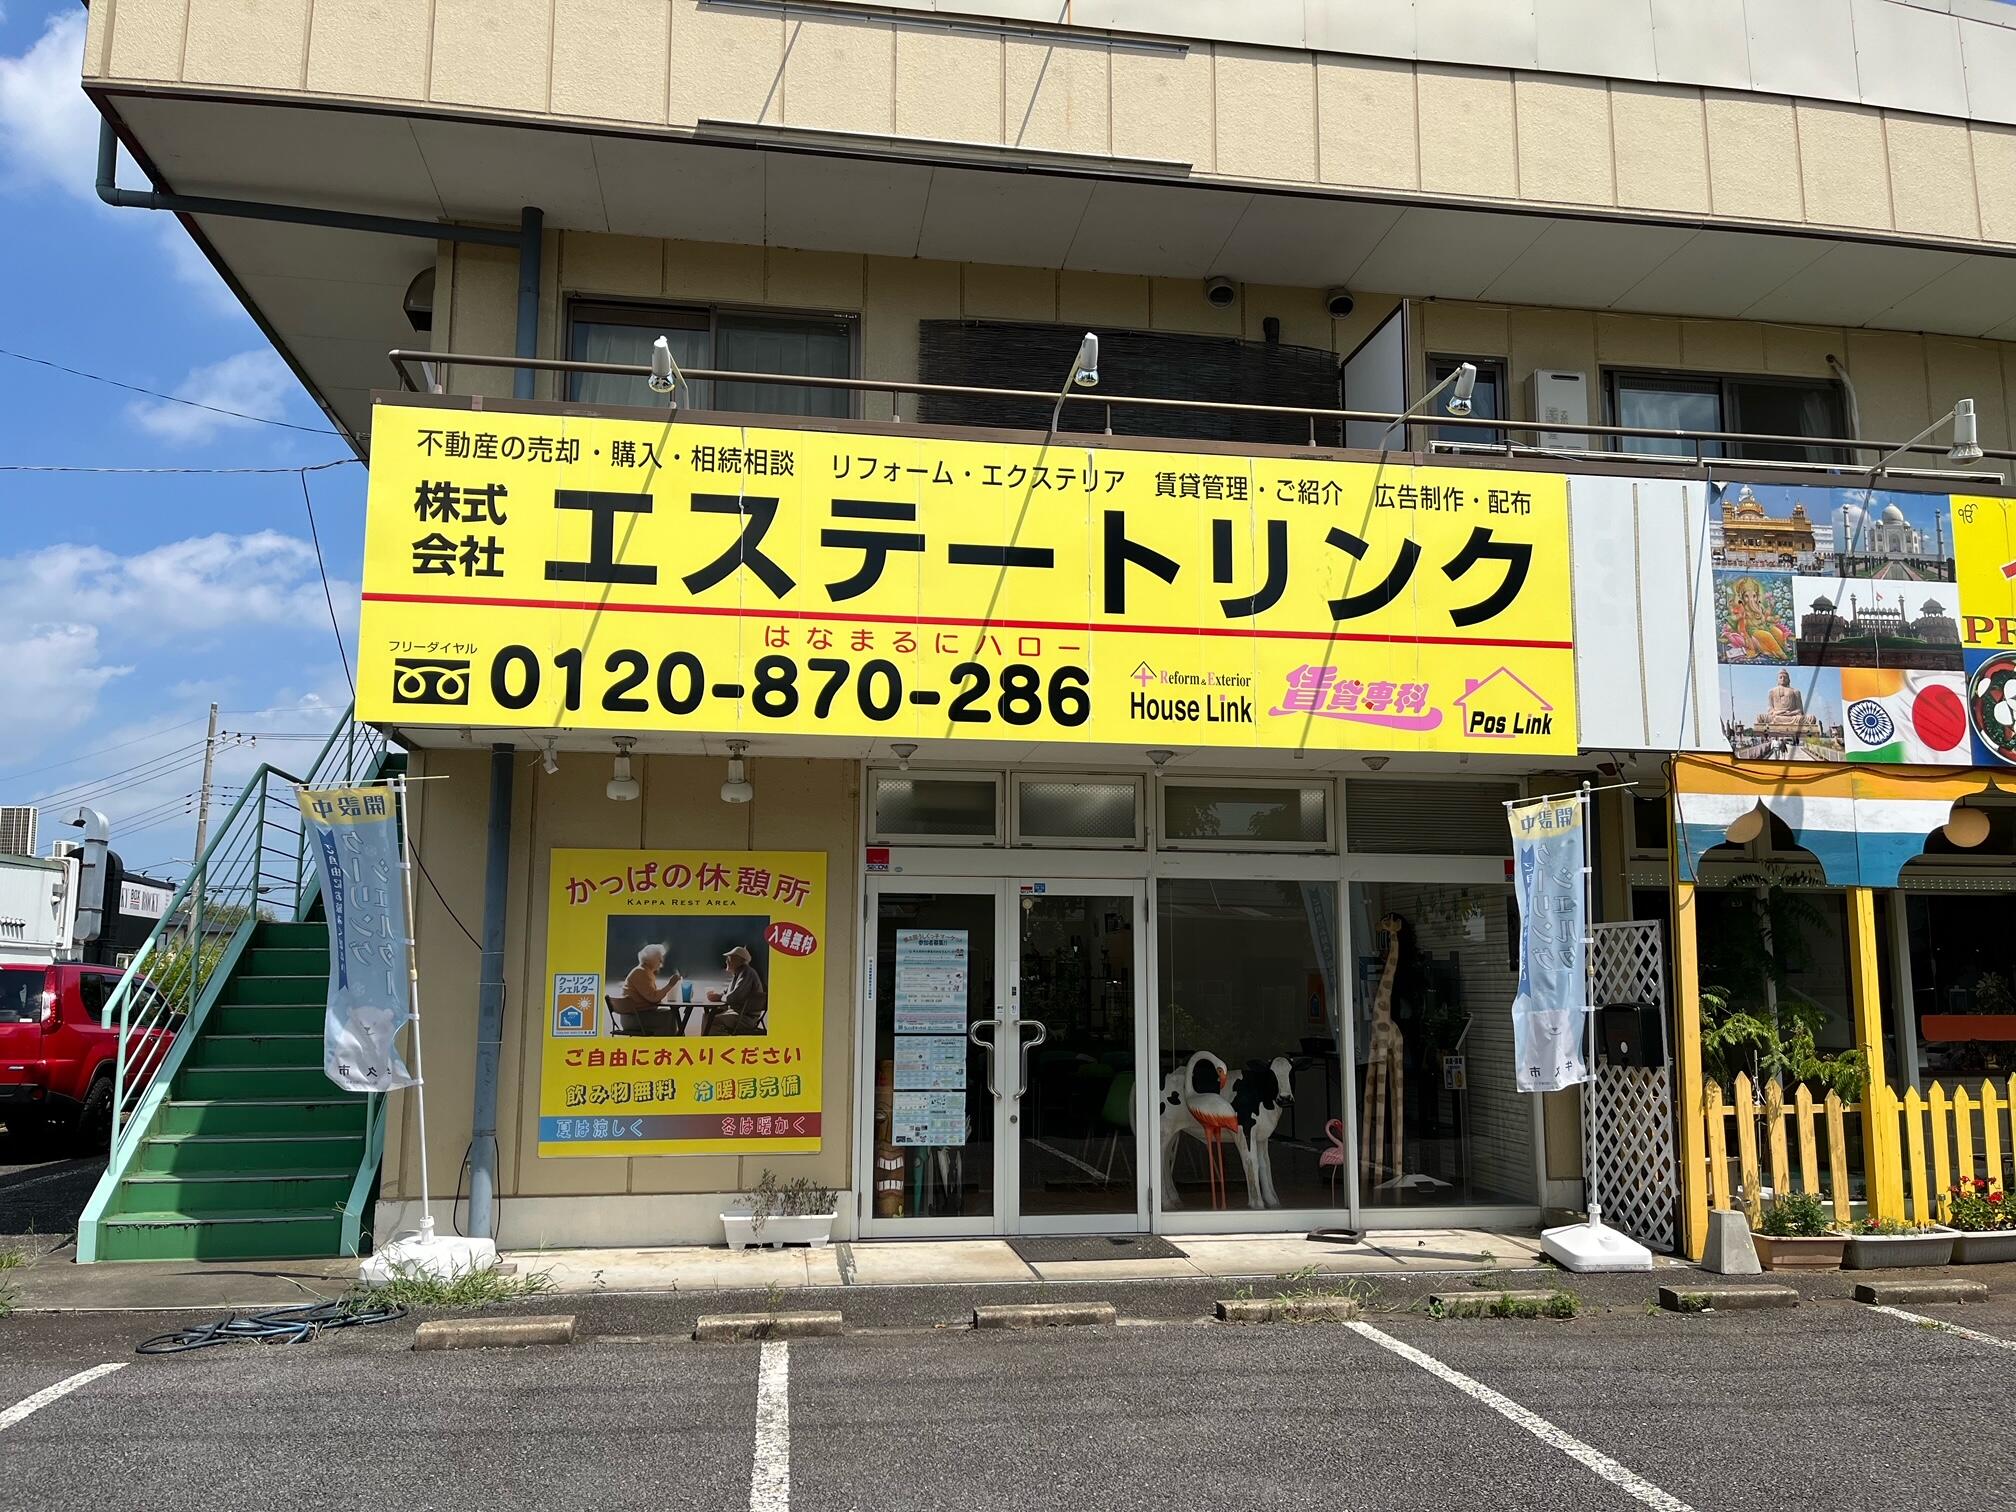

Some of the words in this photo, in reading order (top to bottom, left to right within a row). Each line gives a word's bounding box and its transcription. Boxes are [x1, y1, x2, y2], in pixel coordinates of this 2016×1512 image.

[416, 428, 795, 478] 不動産の売却・購入・相続相談
[831, 453, 1126, 495] リフォーム・エクステリア
[1154, 472, 1344, 506] 賃貸管理・ご紹介
[1374, 484, 1532, 517] 広告制作・配布
[413, 480, 508, 524] 株式
[411, 532, 505, 578] 会社
[545, 488, 1534, 627] エステートリンク
[388, 639, 478, 656] フリーダイヤル
[763, 622, 1082, 657] はなまるにハロー
[490, 643, 1091, 728] 0120-870-286
[1281, 663, 1430, 715] 賃貸専科
[1130, 691, 1200, 722] House
[1206, 694, 1253, 723] Link
[1469, 711, 1508, 735] Pos
[1512, 712, 1554, 736] Link
[565, 861, 811, 908] かっぱの休憩所
[766, 924, 815, 955] 入場無料
[558, 985, 594, 994] シェルター
[559, 976, 595, 986] クーリング
[564, 1046, 802, 1068] ご自由にお入りください
[565, 1077, 677, 1107] 飲み物無料
[693, 1074, 801, 1102] 冷暖房完備
[556, 1117, 645, 1139] 夏は涼しく
[721, 1115, 806, 1137] 冬は暖かく
